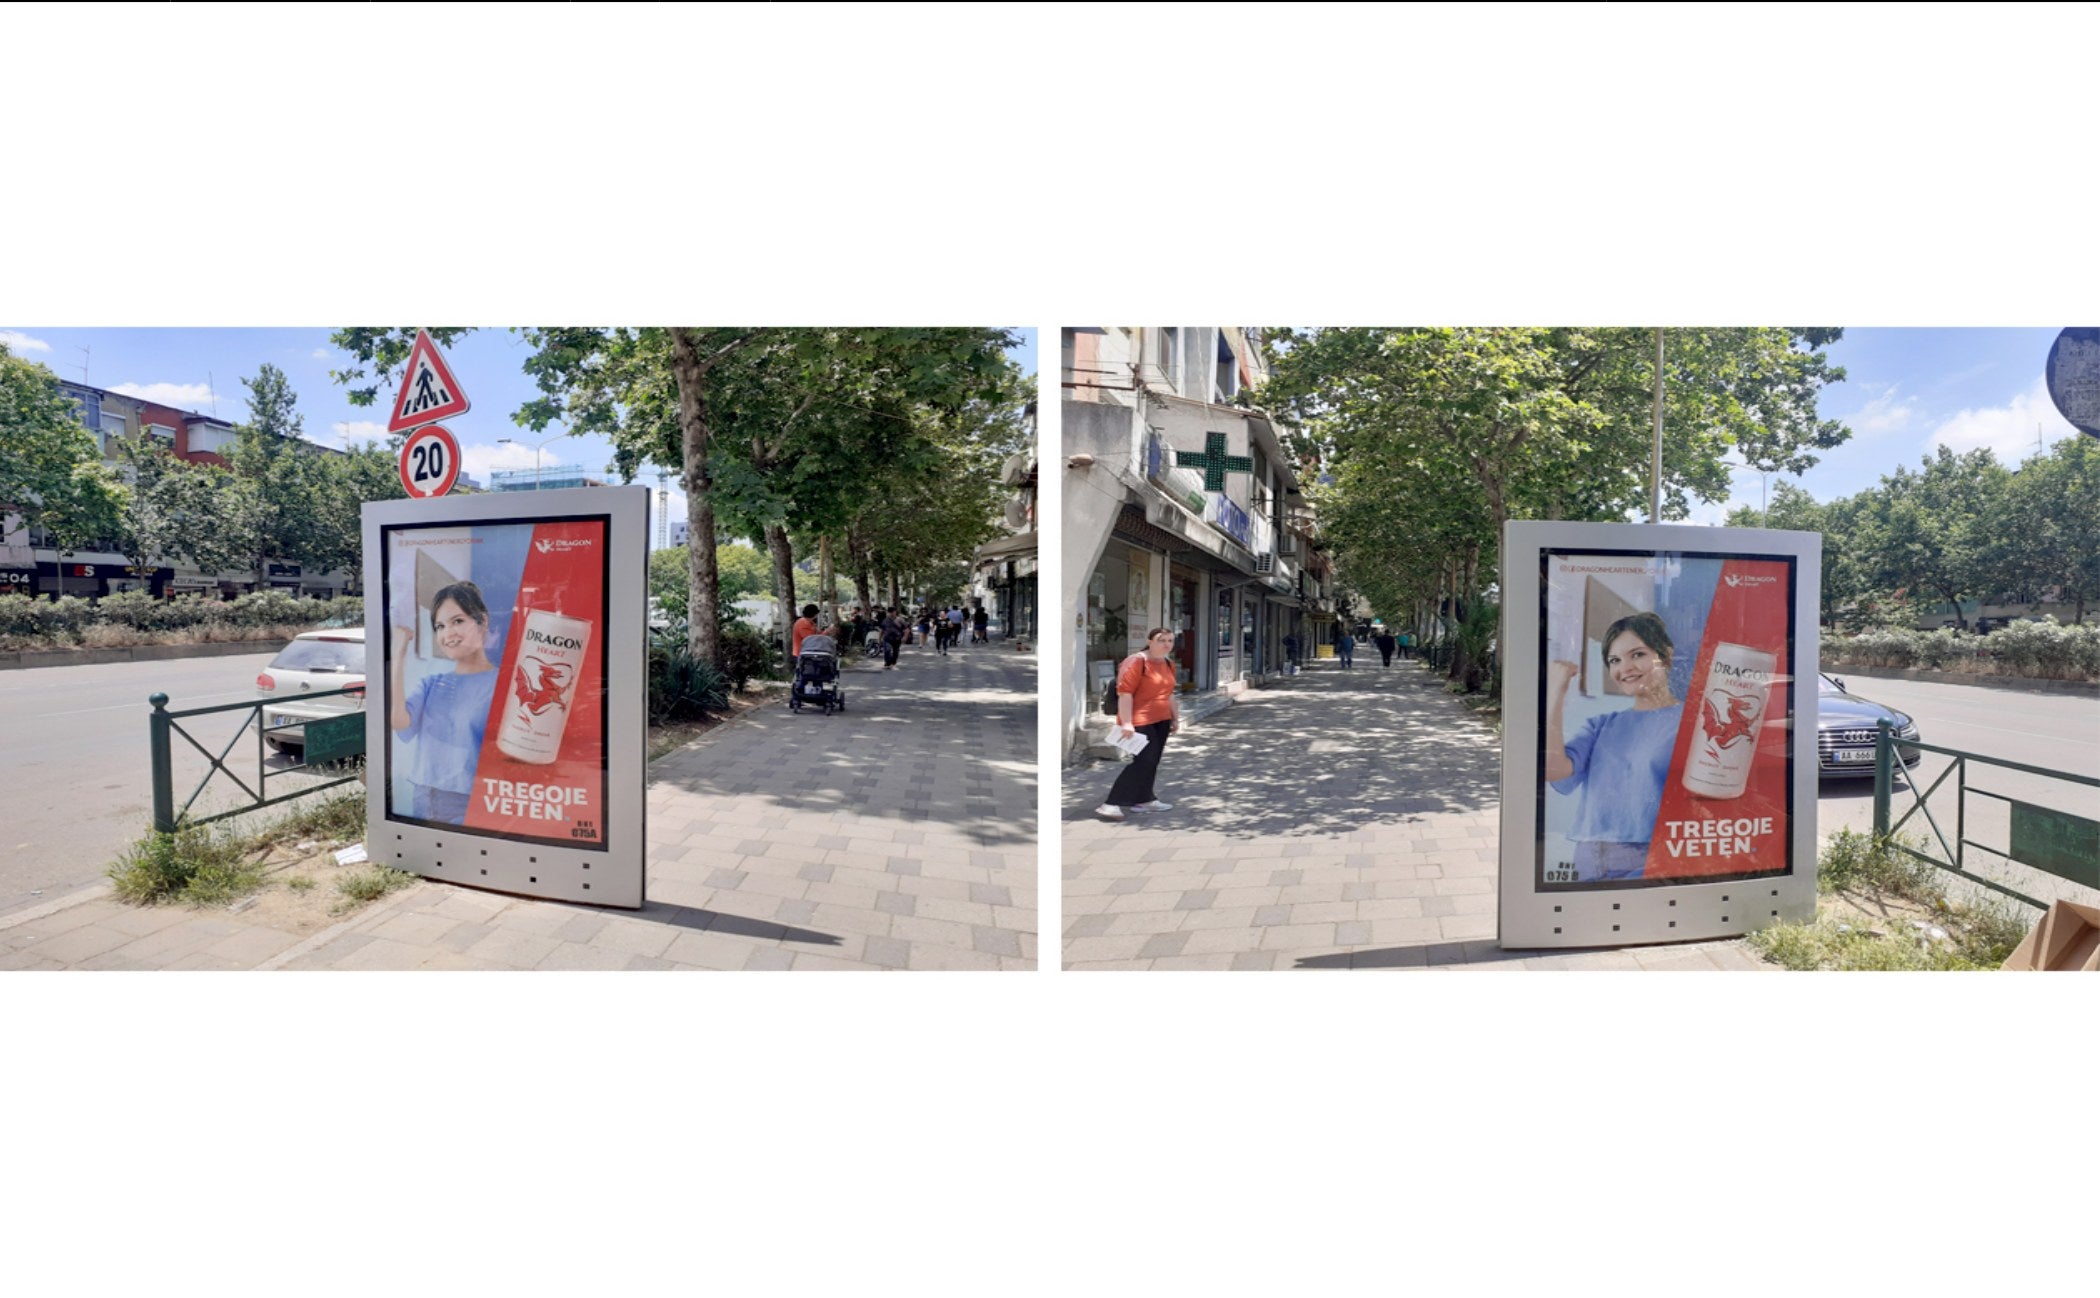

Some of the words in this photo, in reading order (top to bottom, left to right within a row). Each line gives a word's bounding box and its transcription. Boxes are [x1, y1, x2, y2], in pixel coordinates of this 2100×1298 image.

[413, 441, 443, 482] 20
[526, 628, 583, 651] DRAGON
[1714, 661, 1769, 682] DRAGON
[483, 778, 589, 806] TREGOJE
[484, 795, 571, 822] VETEN.
[1665, 816, 1774, 839] TREGOJE
